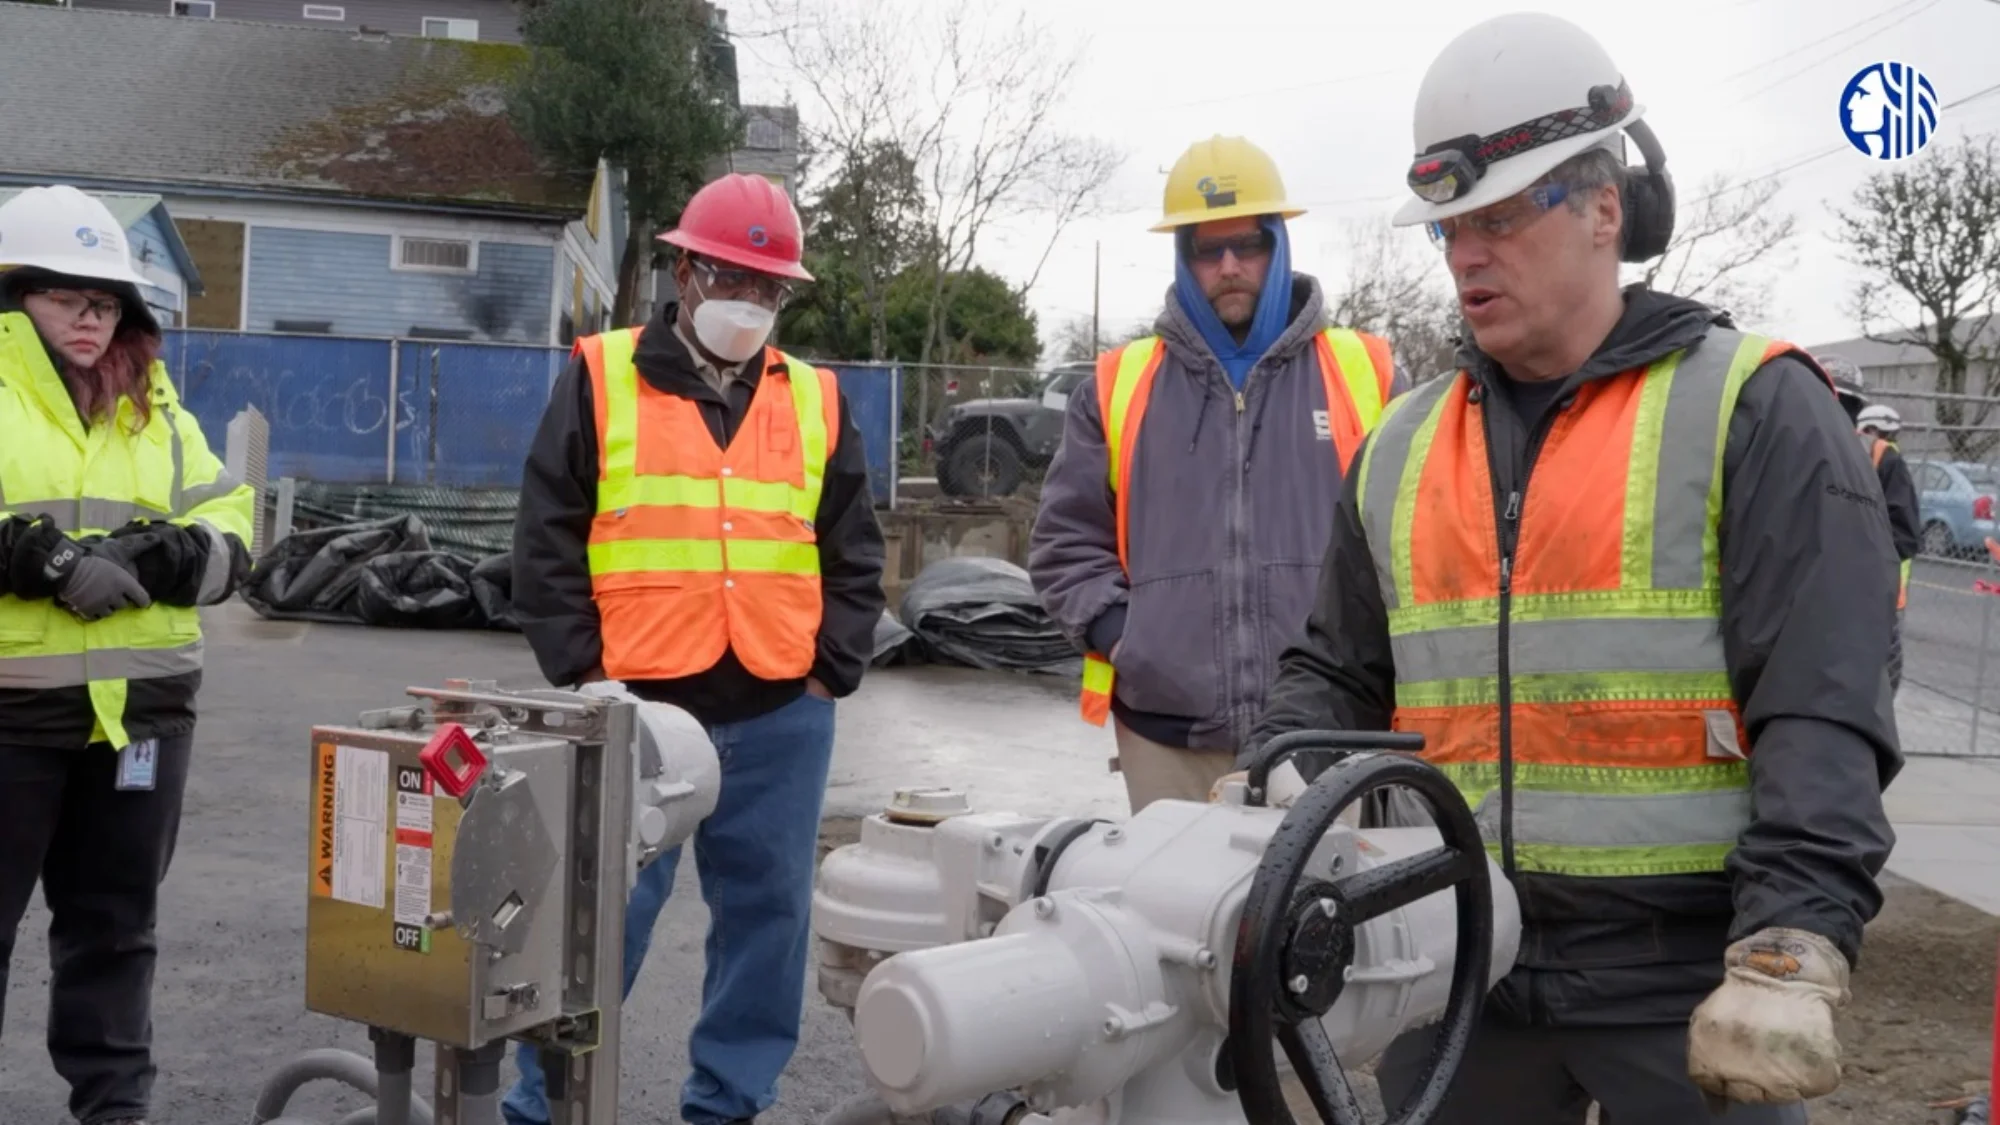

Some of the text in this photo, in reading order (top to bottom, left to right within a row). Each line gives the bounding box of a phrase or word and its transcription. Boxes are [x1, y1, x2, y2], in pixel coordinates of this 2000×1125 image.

[400, 769, 421, 789] ON
[321, 754, 334, 859] WARNING
[395, 926, 419, 946] OFF
